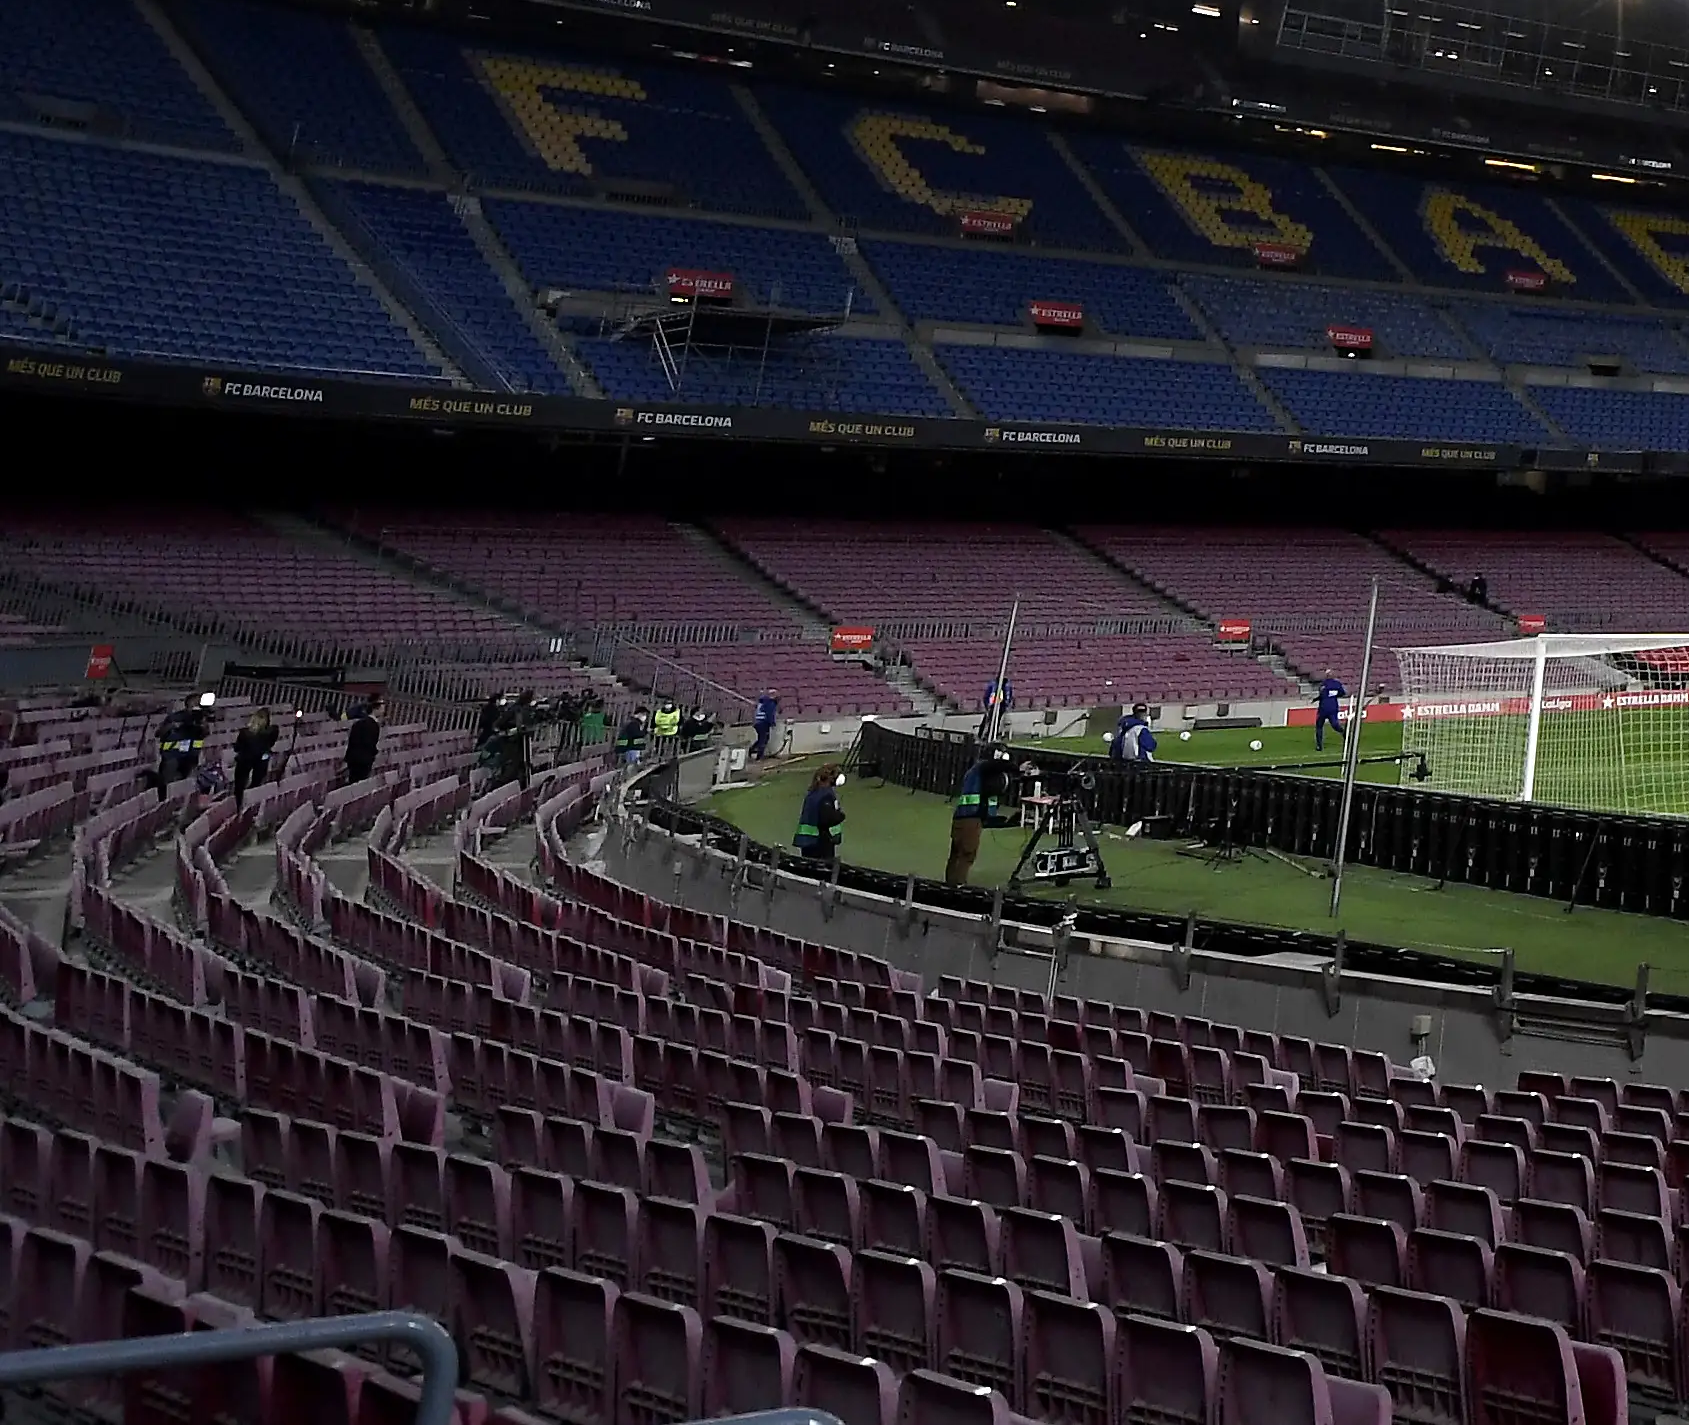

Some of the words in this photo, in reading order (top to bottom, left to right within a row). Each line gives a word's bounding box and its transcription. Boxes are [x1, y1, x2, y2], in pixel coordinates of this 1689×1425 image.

[1042, 308, 1082, 320] ESTRELLA
[38, 360, 64, 377] QUE
[65, 363, 84, 380] UN
[86, 368, 123, 384] CLUB
[224, 382, 242, 396] FC
[243, 384, 324, 403] BARCELONA
[409, 395, 440, 411] MÉS
[441, 400, 470, 414] QUE
[472, 401, 493, 414] UN
[495, 403, 533, 417] CLUB
[636, 412, 654, 424] FC
[655, 412, 732, 428] BARCELONA
[808, 419, 836, 434] MÉS
[837, 423, 863, 435] QUE
[864, 425, 883, 436] UN
[884, 426, 915, 438] CLUB
[1002, 431, 1017, 442] FC
[1017, 432, 1081, 444] BARCELONA
[1168, 438, 1189, 449] QUE
[1190, 438, 1205, 449] UN
[1206, 439, 1232, 450] CLUB
[1303, 444, 1315, 454] FC
[1316, 444, 1369, 456] BARCELONA
[1541, 699, 1572, 711] LaLiga
[1617, 695, 1660, 706] ESTRELLA
[1661, 693, 1689, 703] DAMM
[1417, 704, 1466, 716] ESTRELLA
[1467, 702, 1500, 713] DAMM
